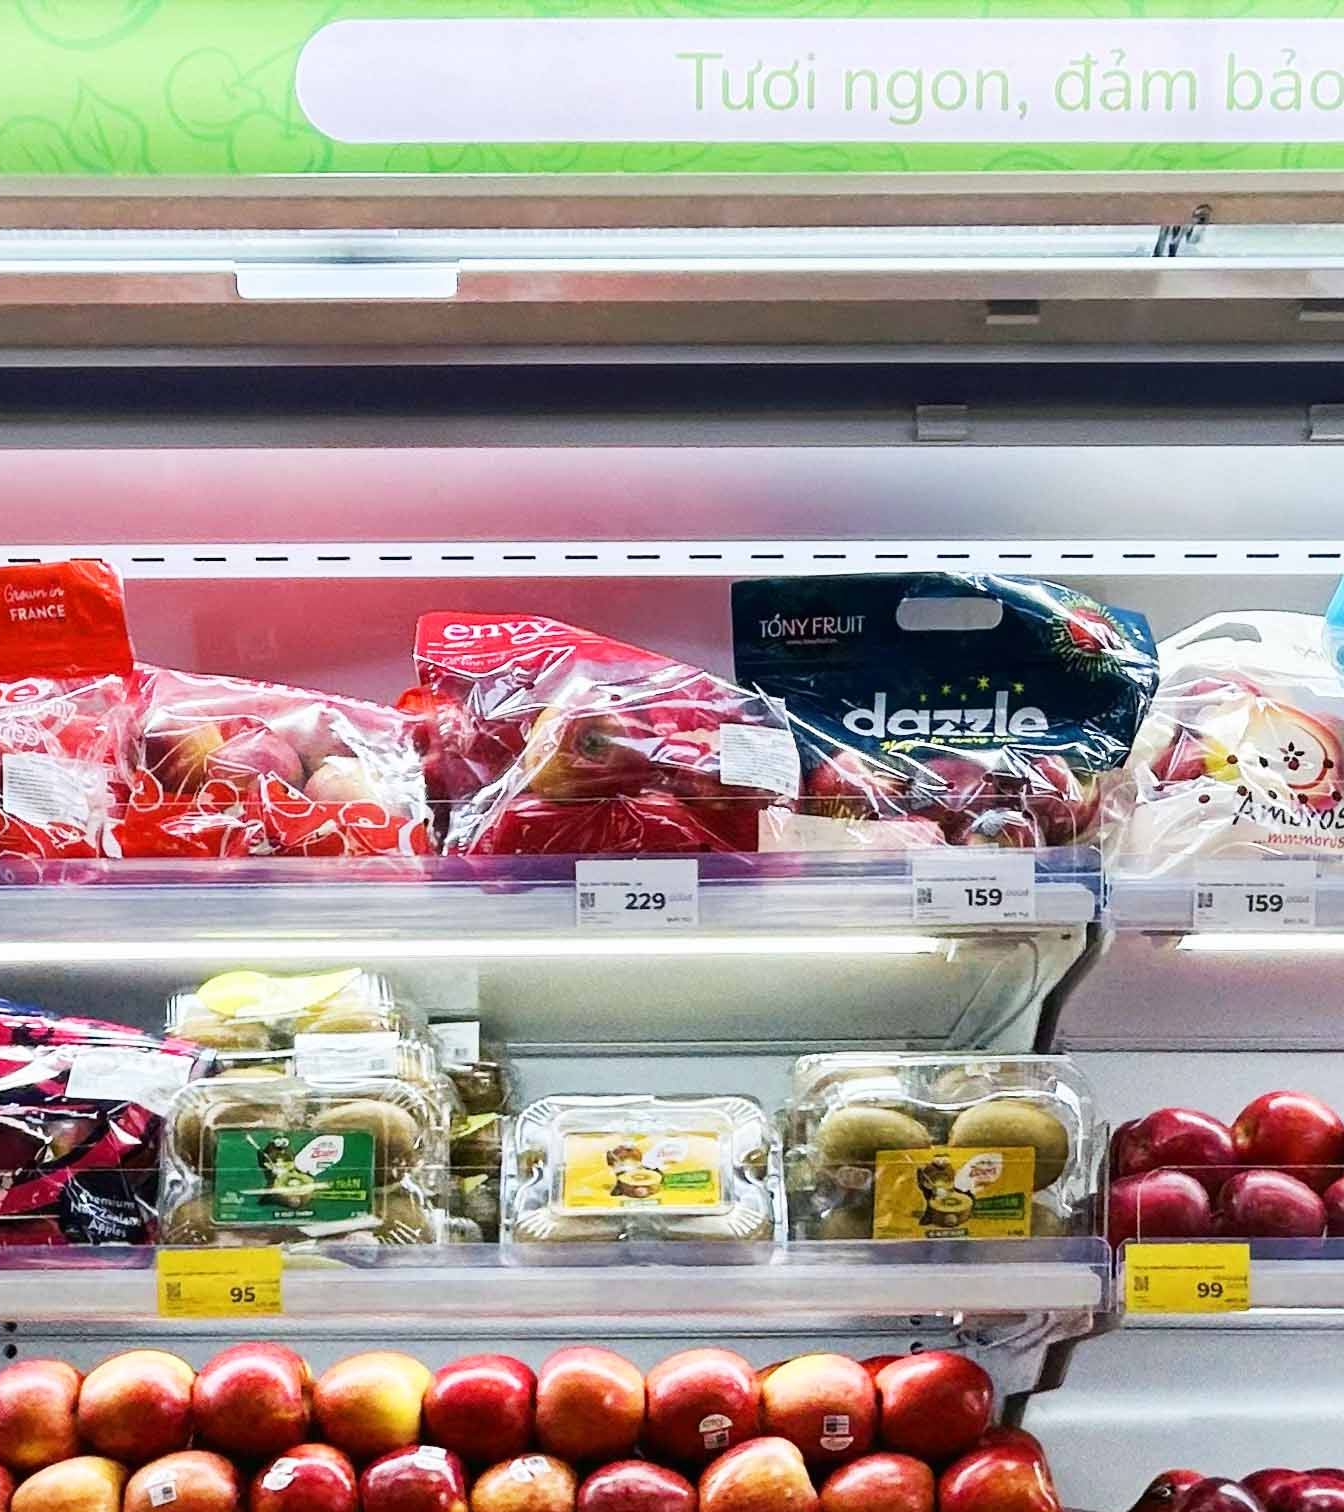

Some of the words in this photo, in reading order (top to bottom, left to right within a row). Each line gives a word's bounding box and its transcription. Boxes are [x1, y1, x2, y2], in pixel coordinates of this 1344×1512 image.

[675, 51, 816, 112] Tươi
[844, 67, 1029, 125] ngon,
[1055, 47, 1197, 112] đảm
[9, 604, 67, 622] FRANCE
[443, 621, 564, 645] envy
[812, 615, 866, 635] FRUIT
[842, 690, 1049, 739] dazzle
[624, 892, 667, 911] 229
[964, 888, 1003, 908] 159
[1245, 894, 1283, 913] 159
[230, 1286, 256, 1304] 95
[1197, 1281, 1224, 1300] 99
